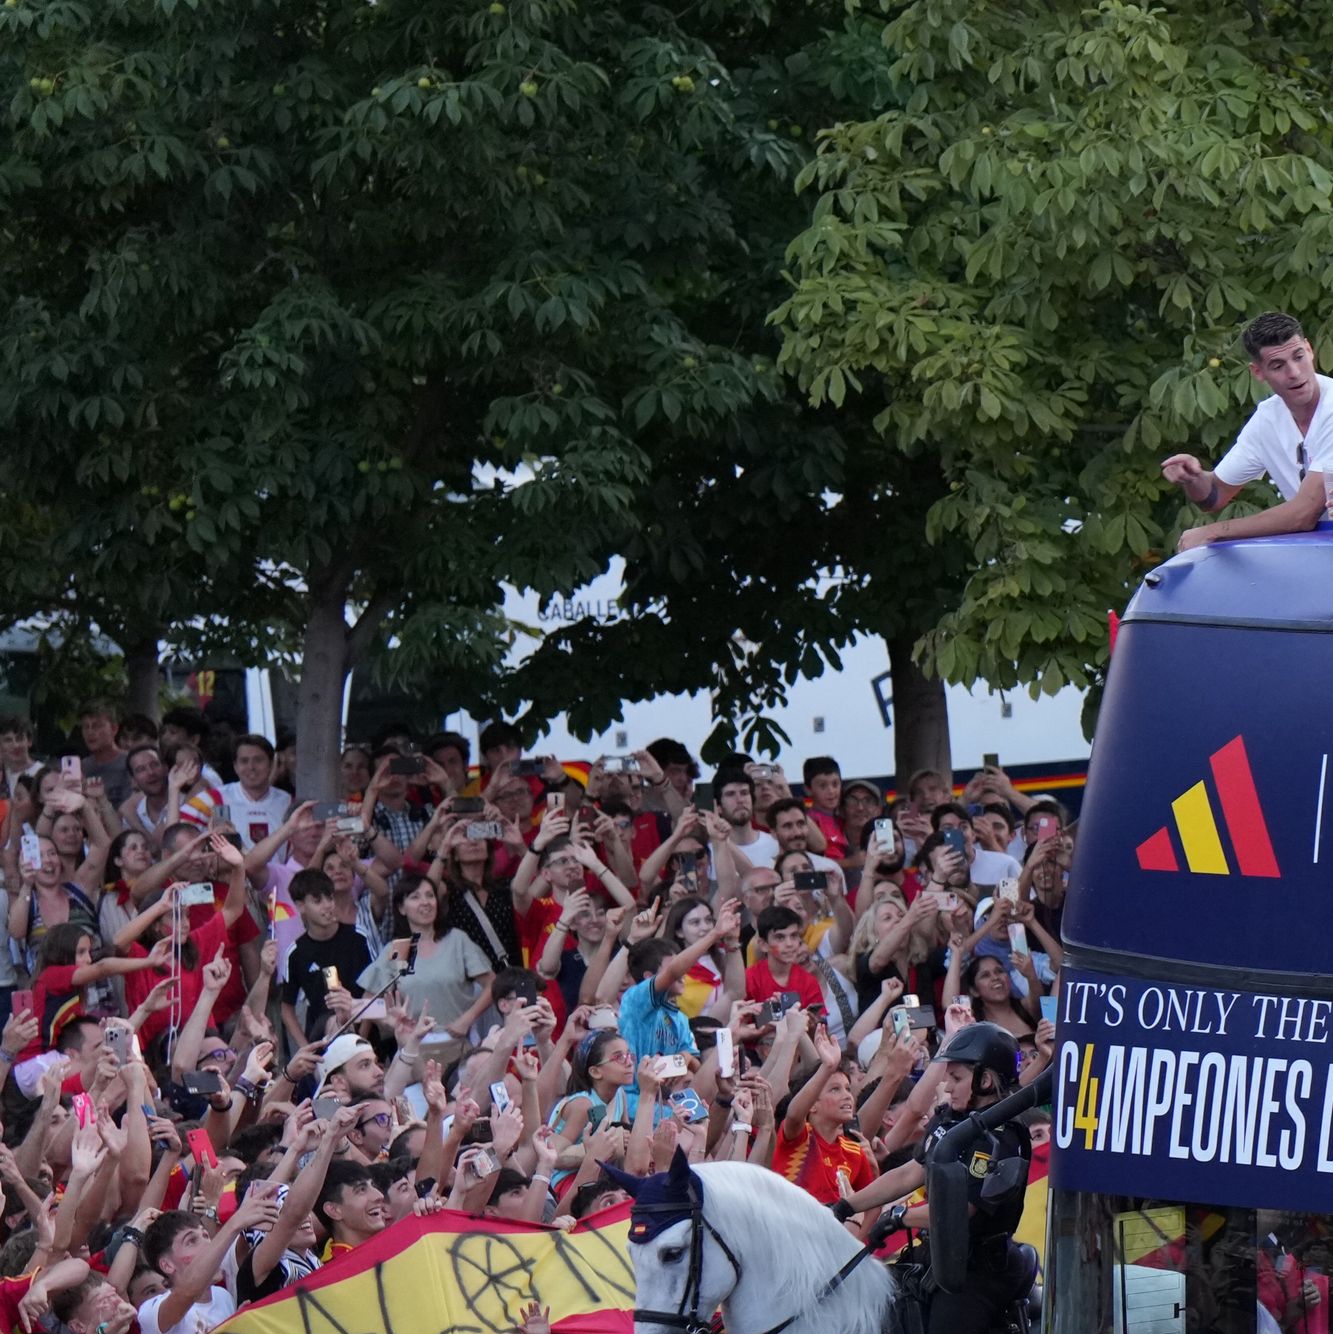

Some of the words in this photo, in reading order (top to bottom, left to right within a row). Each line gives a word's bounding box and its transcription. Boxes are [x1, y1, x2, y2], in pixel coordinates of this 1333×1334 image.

[1137, 987, 1241, 1037] ONLY
[1252, 998, 1333, 1044] THE
[1056, 1040, 1312, 1172] C4MPEONES
